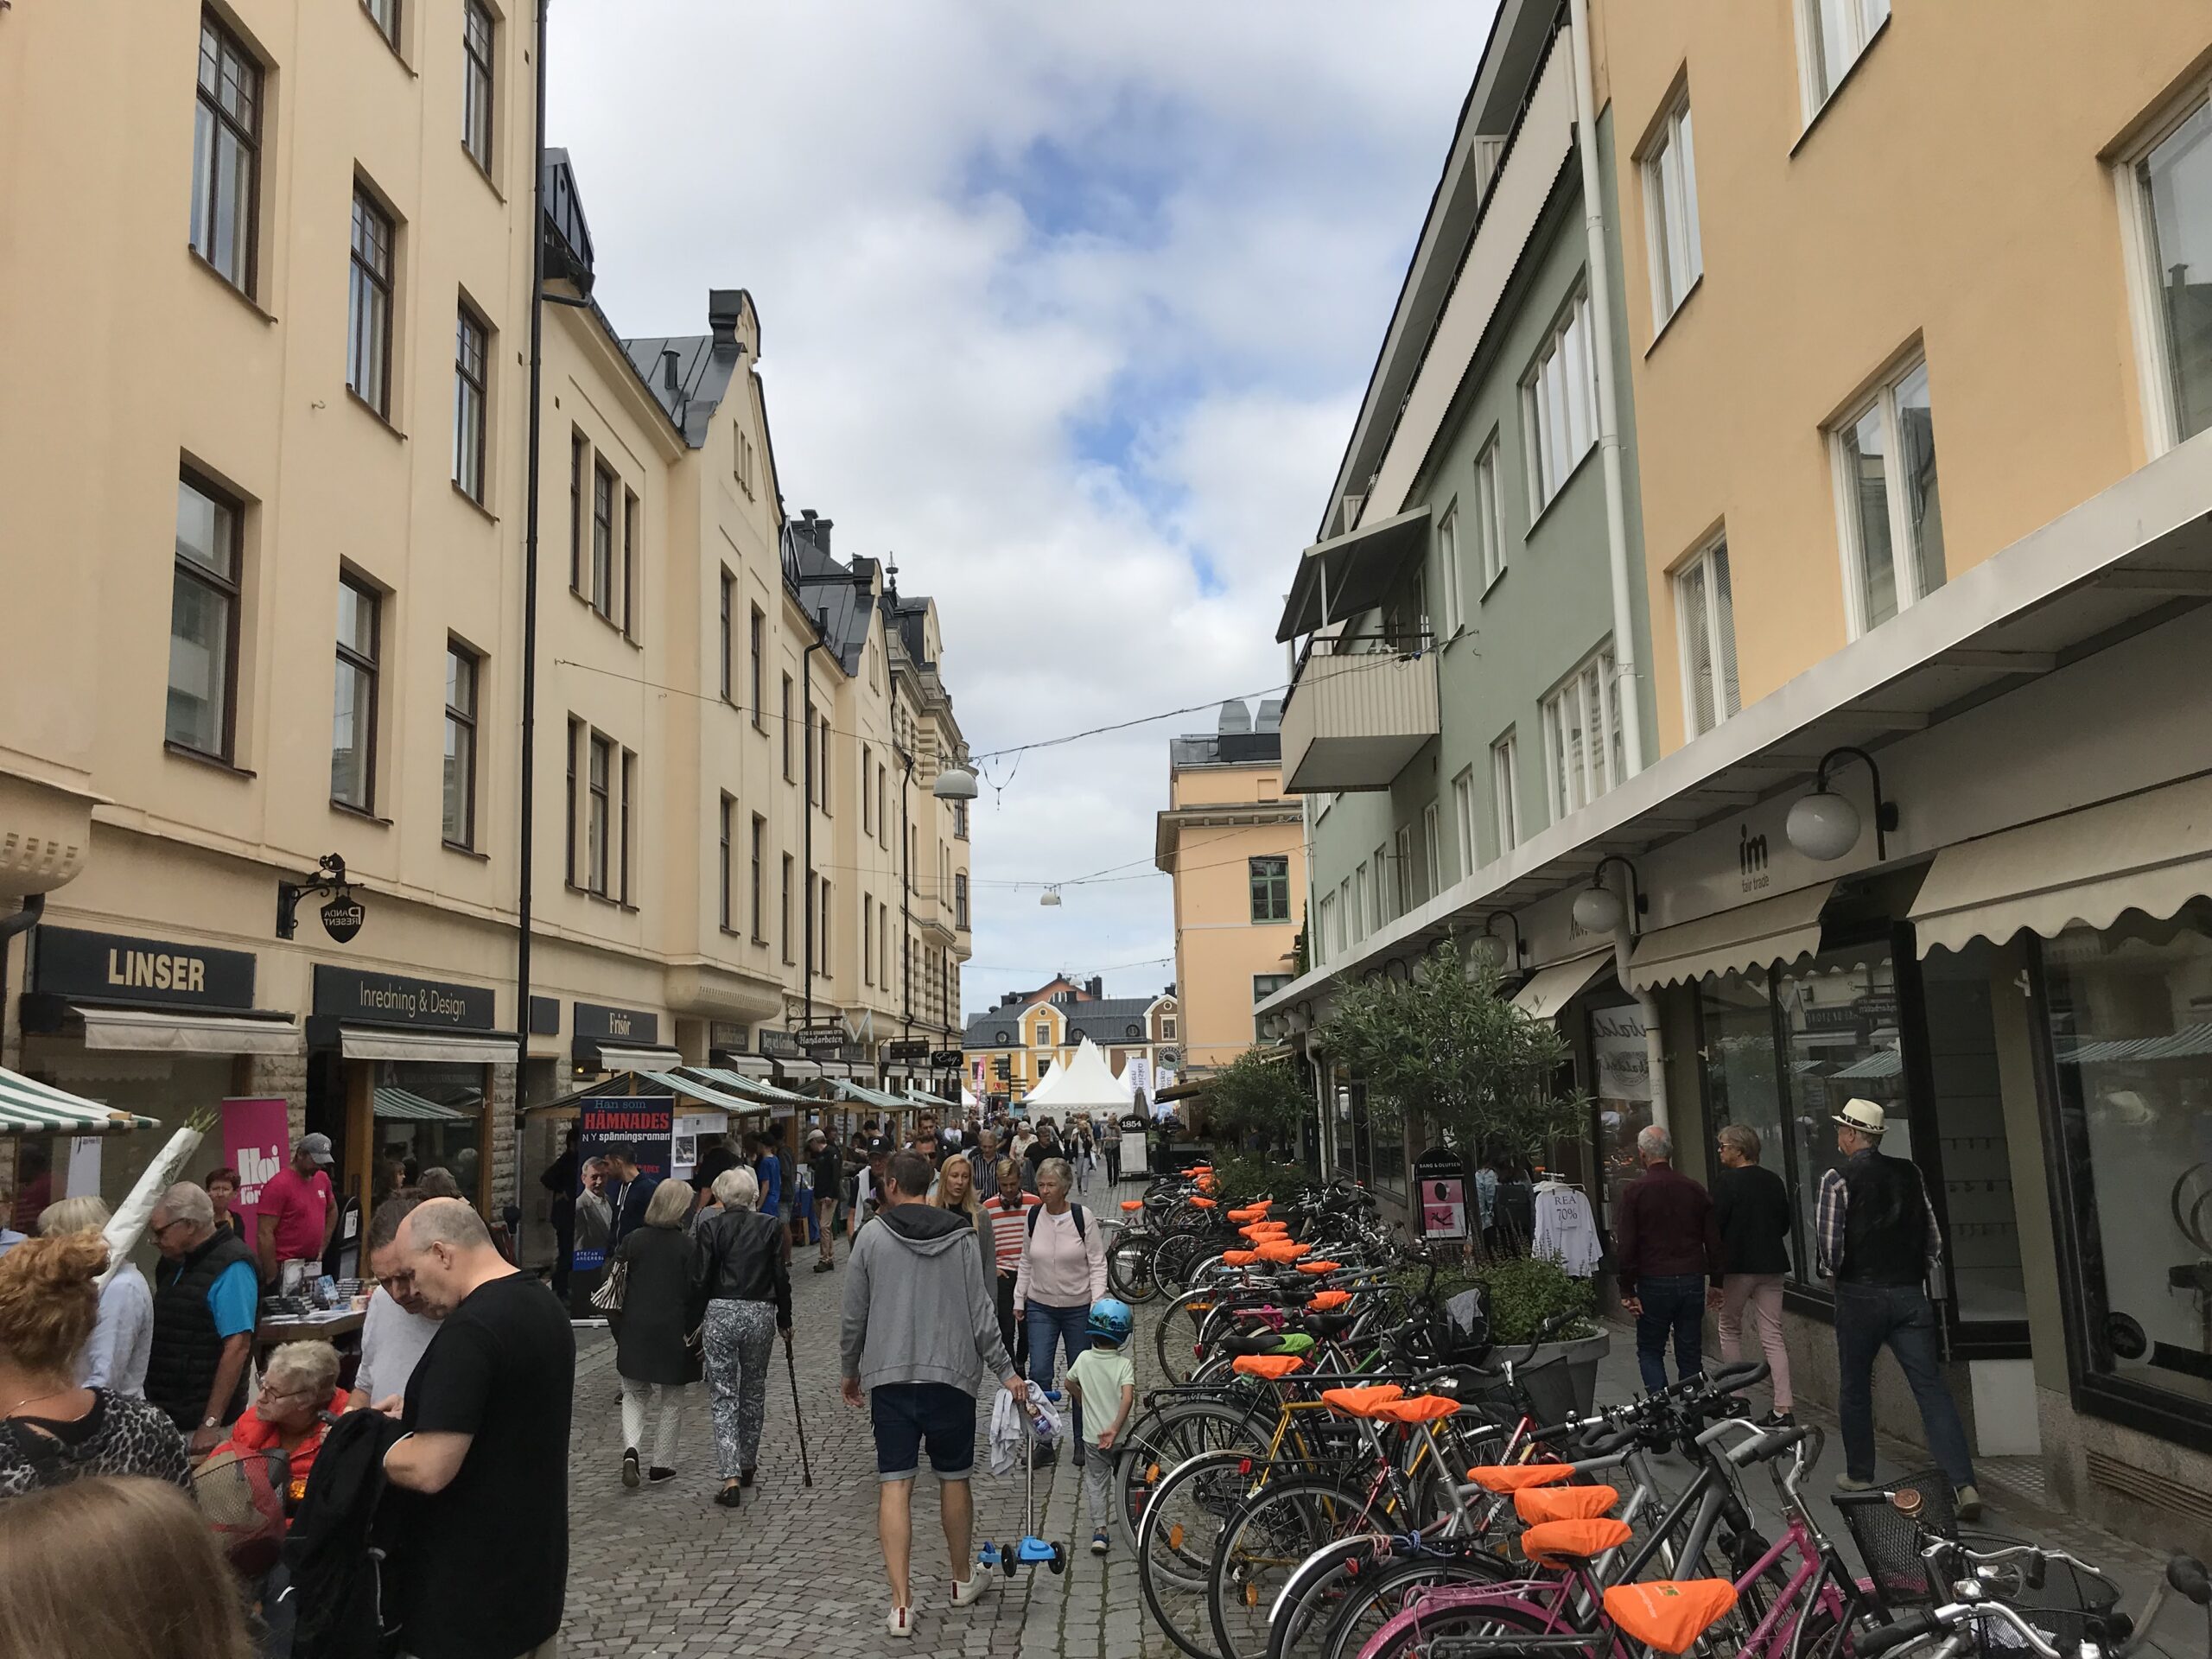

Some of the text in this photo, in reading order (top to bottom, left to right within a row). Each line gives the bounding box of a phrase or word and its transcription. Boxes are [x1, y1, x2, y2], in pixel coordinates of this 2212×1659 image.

[108, 948, 205, 992] LINSER
[360, 980, 466, 1021] Inredning & Design
[609, 1012, 632, 1035] Frisör
[798, 1035, 843, 1045] Handarbeten
[594, 1100, 646, 1109] Han som
[584, 1109, 670, 1130] HÄMNADES
[599, 1131, 671, 1143] spänningsroman
[240, 1185, 264, 1205] för
[1555, 1195, 1576, 1205] REA
[1556, 1208, 1578, 1221] 70%
